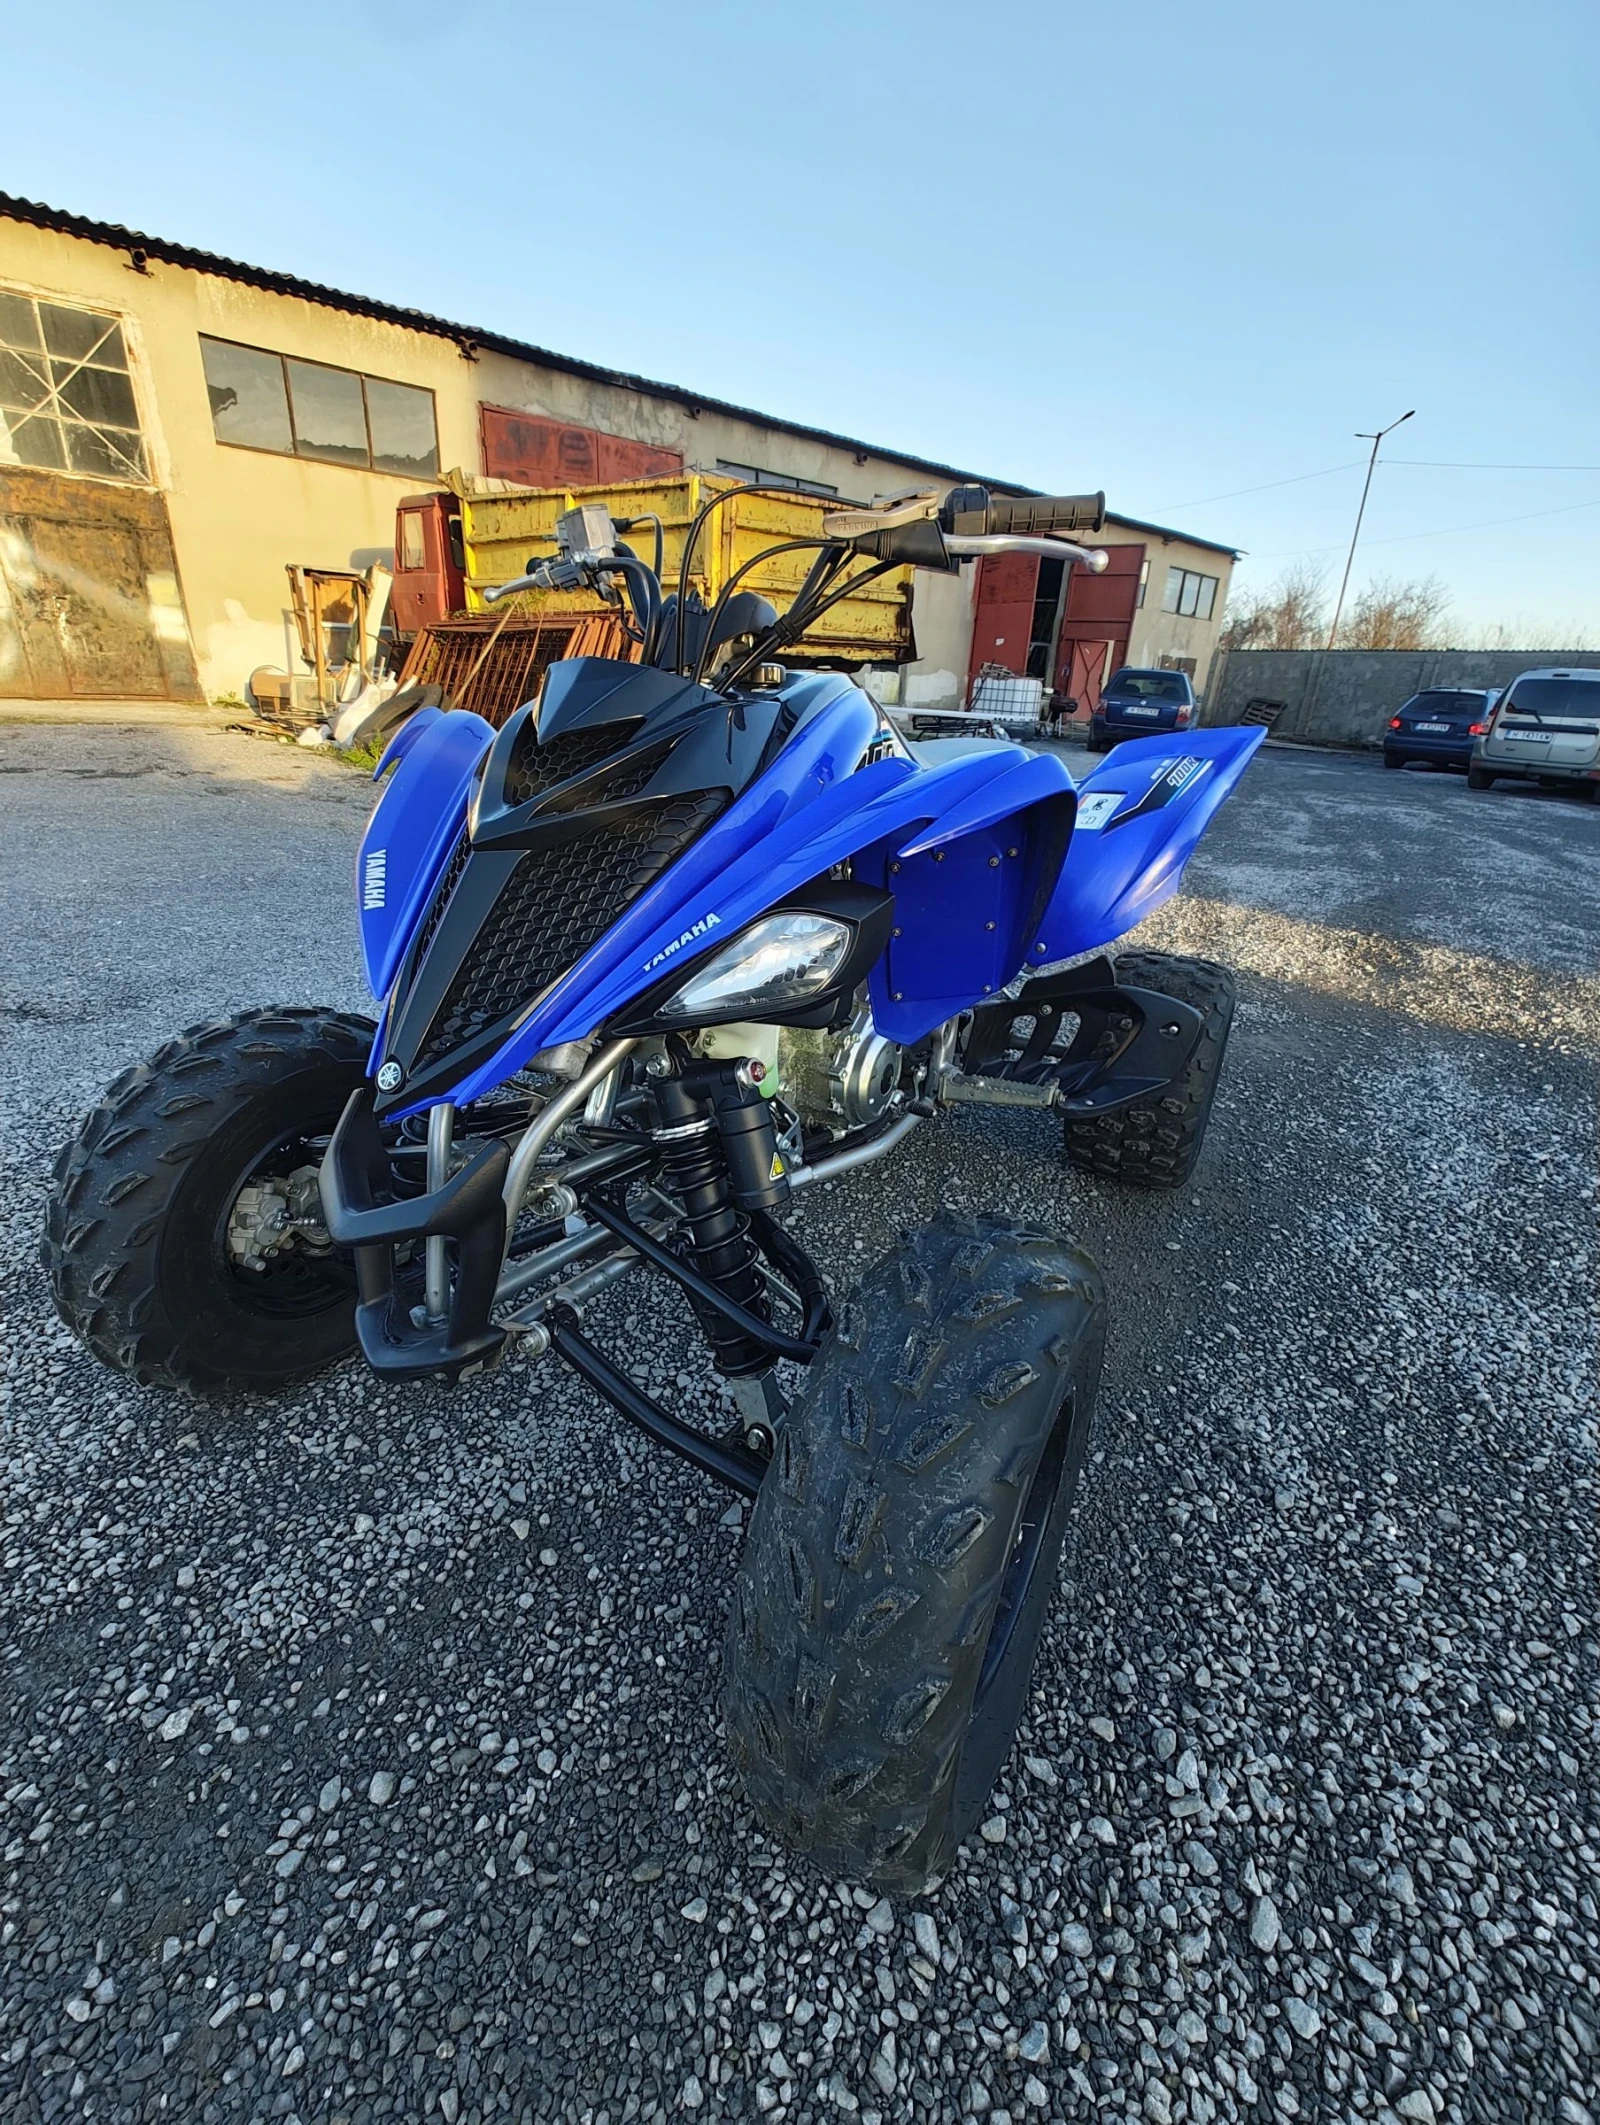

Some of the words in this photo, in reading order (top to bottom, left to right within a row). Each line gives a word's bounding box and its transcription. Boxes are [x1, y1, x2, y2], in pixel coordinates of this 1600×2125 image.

[836, 520, 878, 532] PARKING
[363, 848, 386, 910] YAMAHA
[642, 912, 721, 972] YAMAHA
